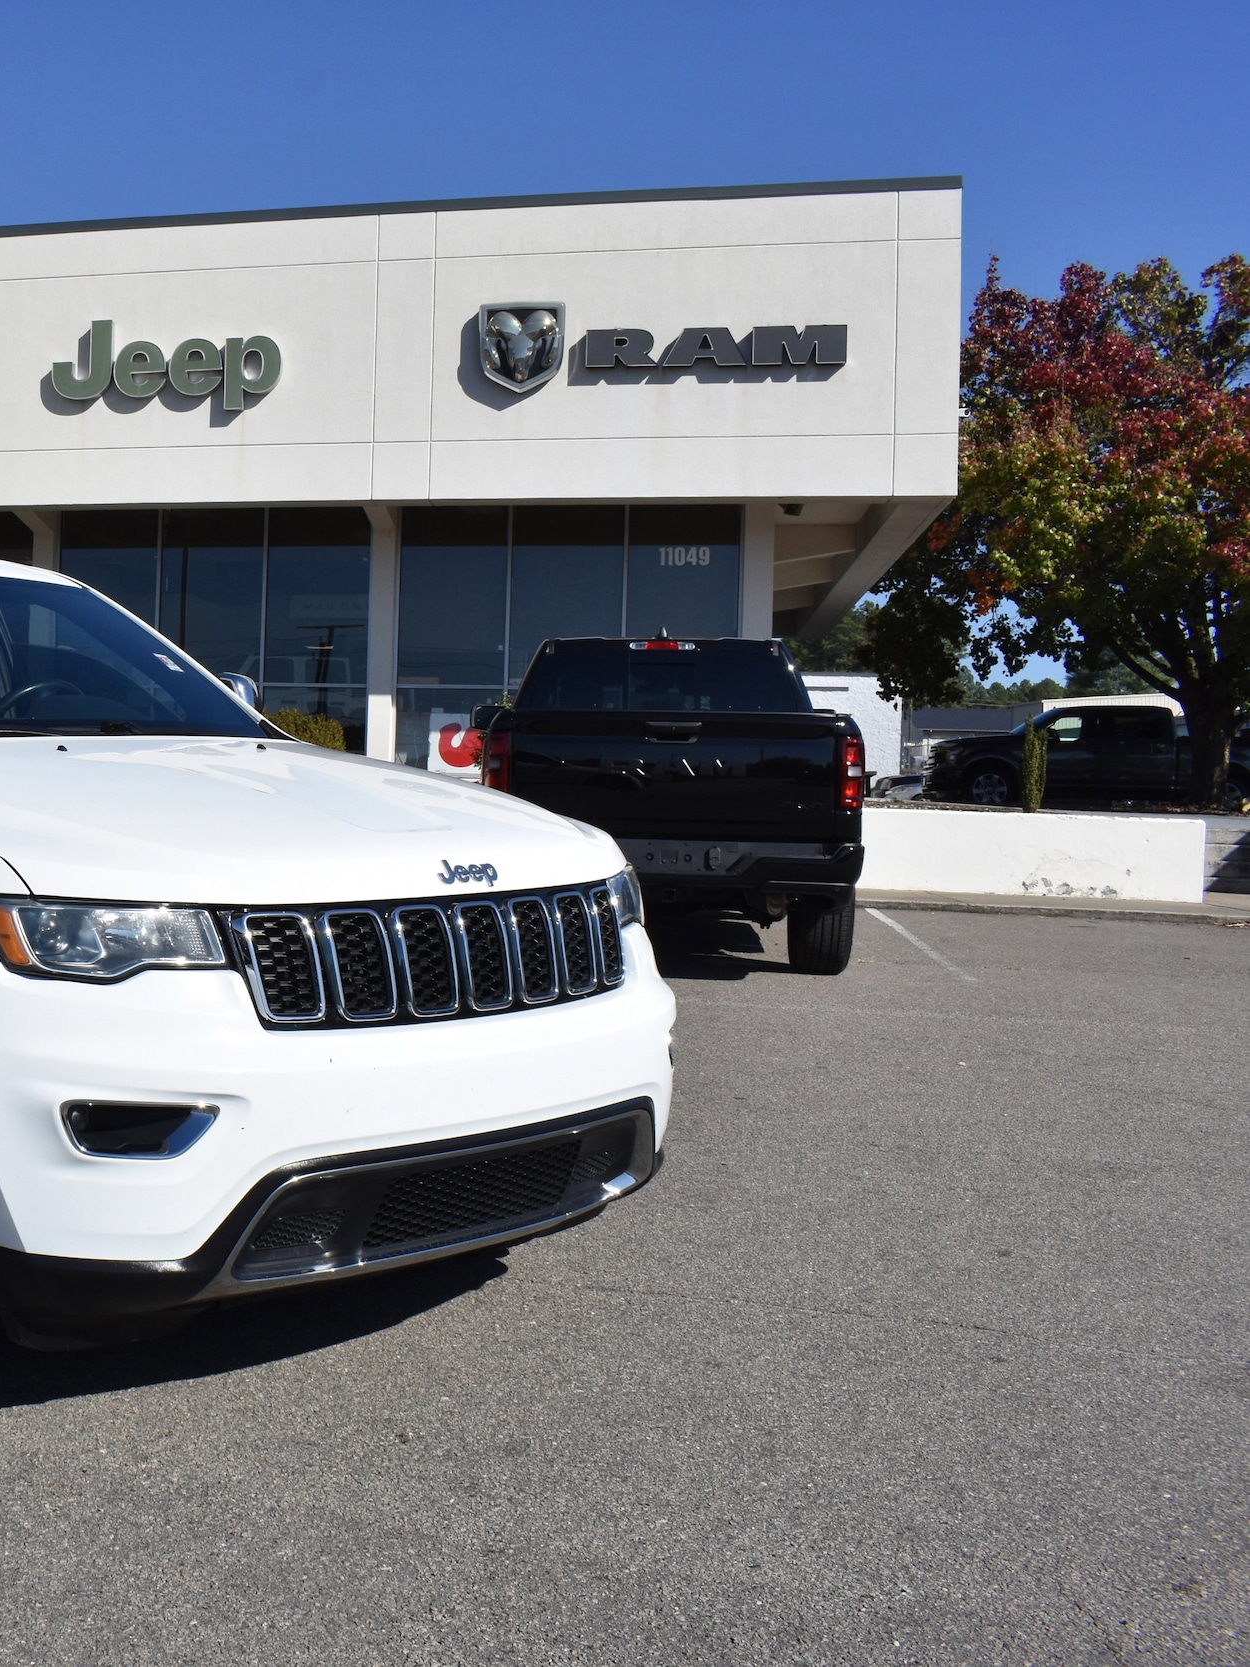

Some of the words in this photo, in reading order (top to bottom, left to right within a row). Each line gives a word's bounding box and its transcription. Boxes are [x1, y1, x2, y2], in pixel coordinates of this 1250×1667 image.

[585, 324, 848, 369] RAM
[51, 319, 284, 411] Jeep
[658, 546, 711, 566] 11049
[437, 859, 499, 887] Jeep
